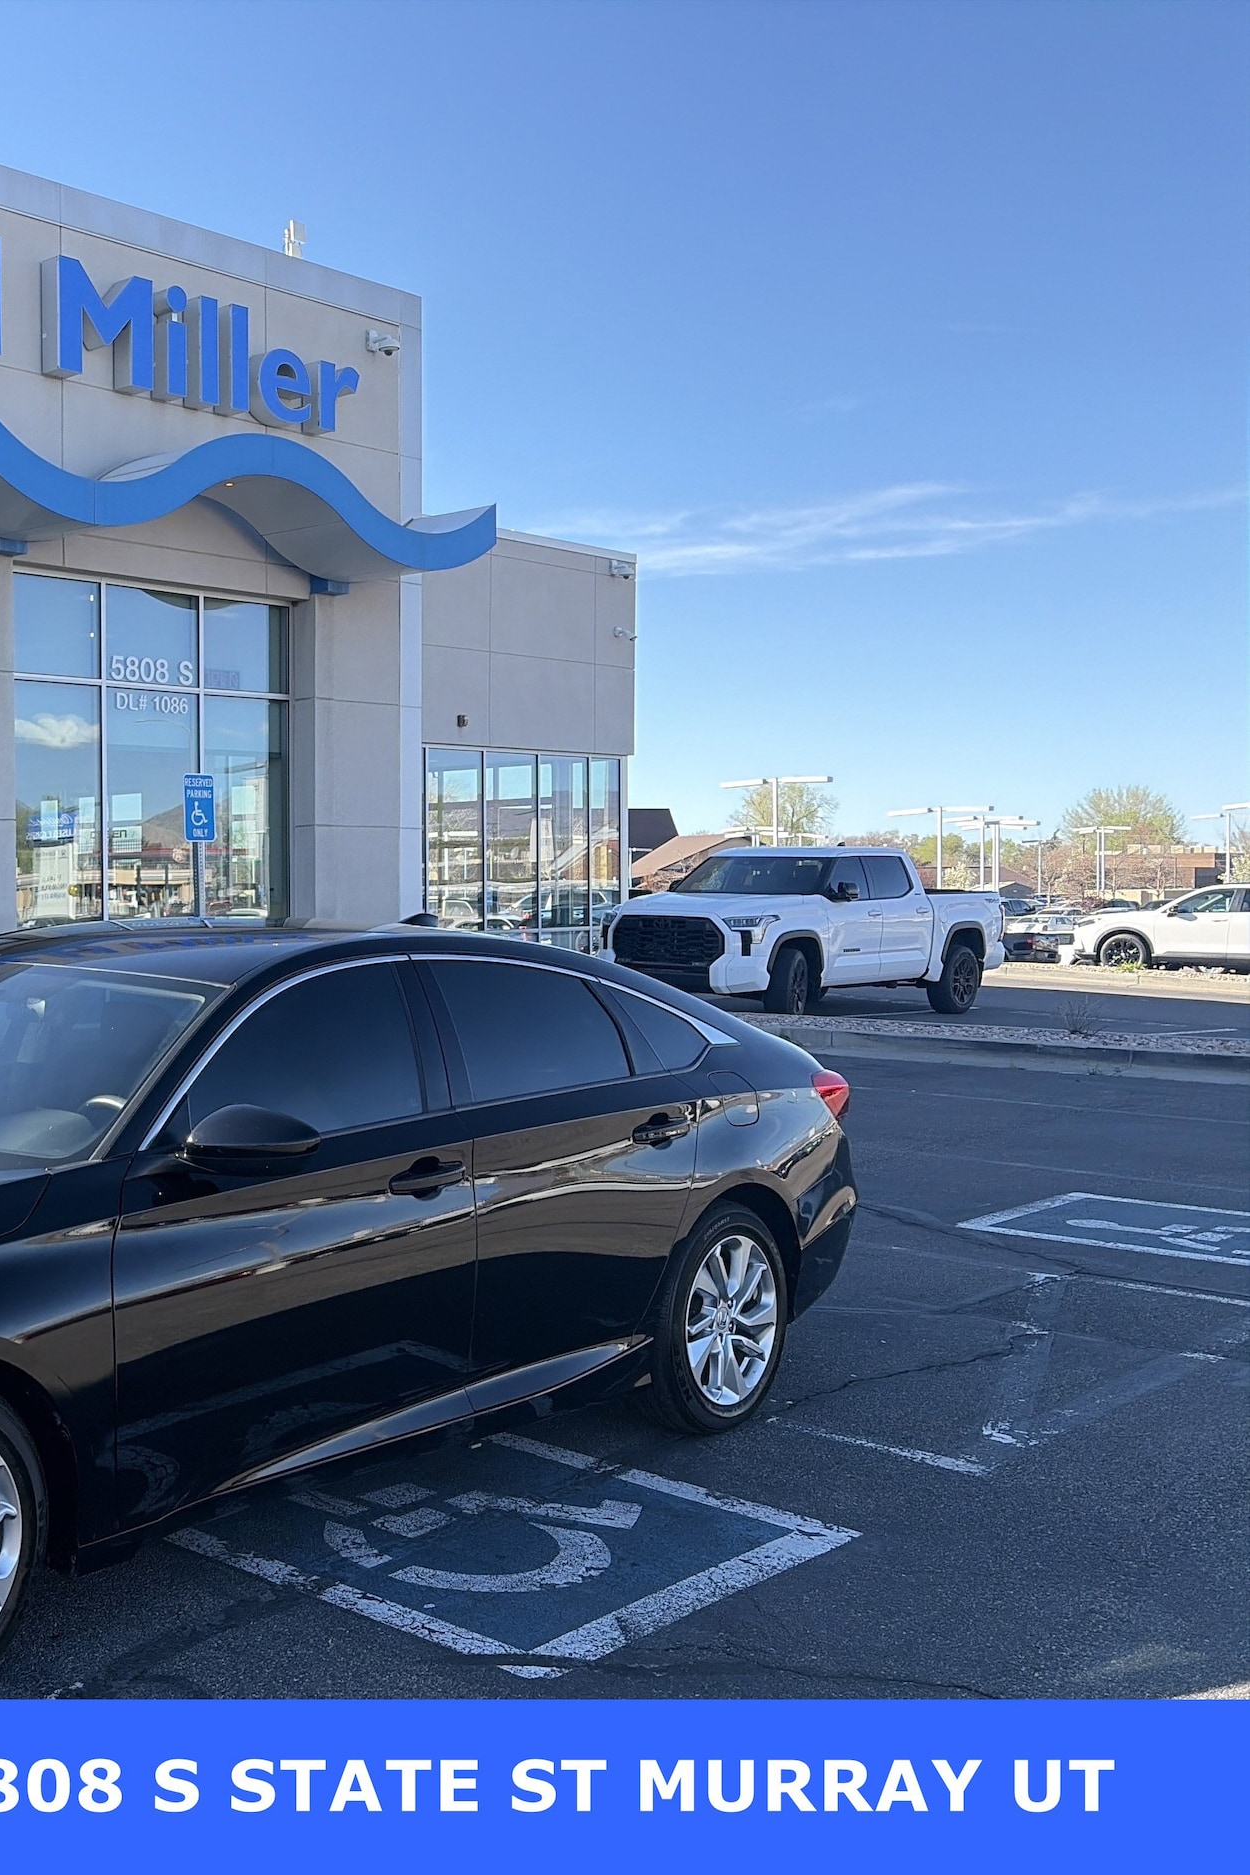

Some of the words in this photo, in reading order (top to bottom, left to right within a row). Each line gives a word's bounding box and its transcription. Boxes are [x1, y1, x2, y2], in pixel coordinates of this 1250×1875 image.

[41, 255, 360, 436] Miller
[110, 655, 169, 684] 5808
[179, 660, 194, 686] S
[116, 692, 148, 712] DL#
[153, 695, 189, 715] 1086
[184, 777, 212, 787] RESERVED
[186, 789, 212, 798] PARKING
[192, 828, 208, 838] ONLY
